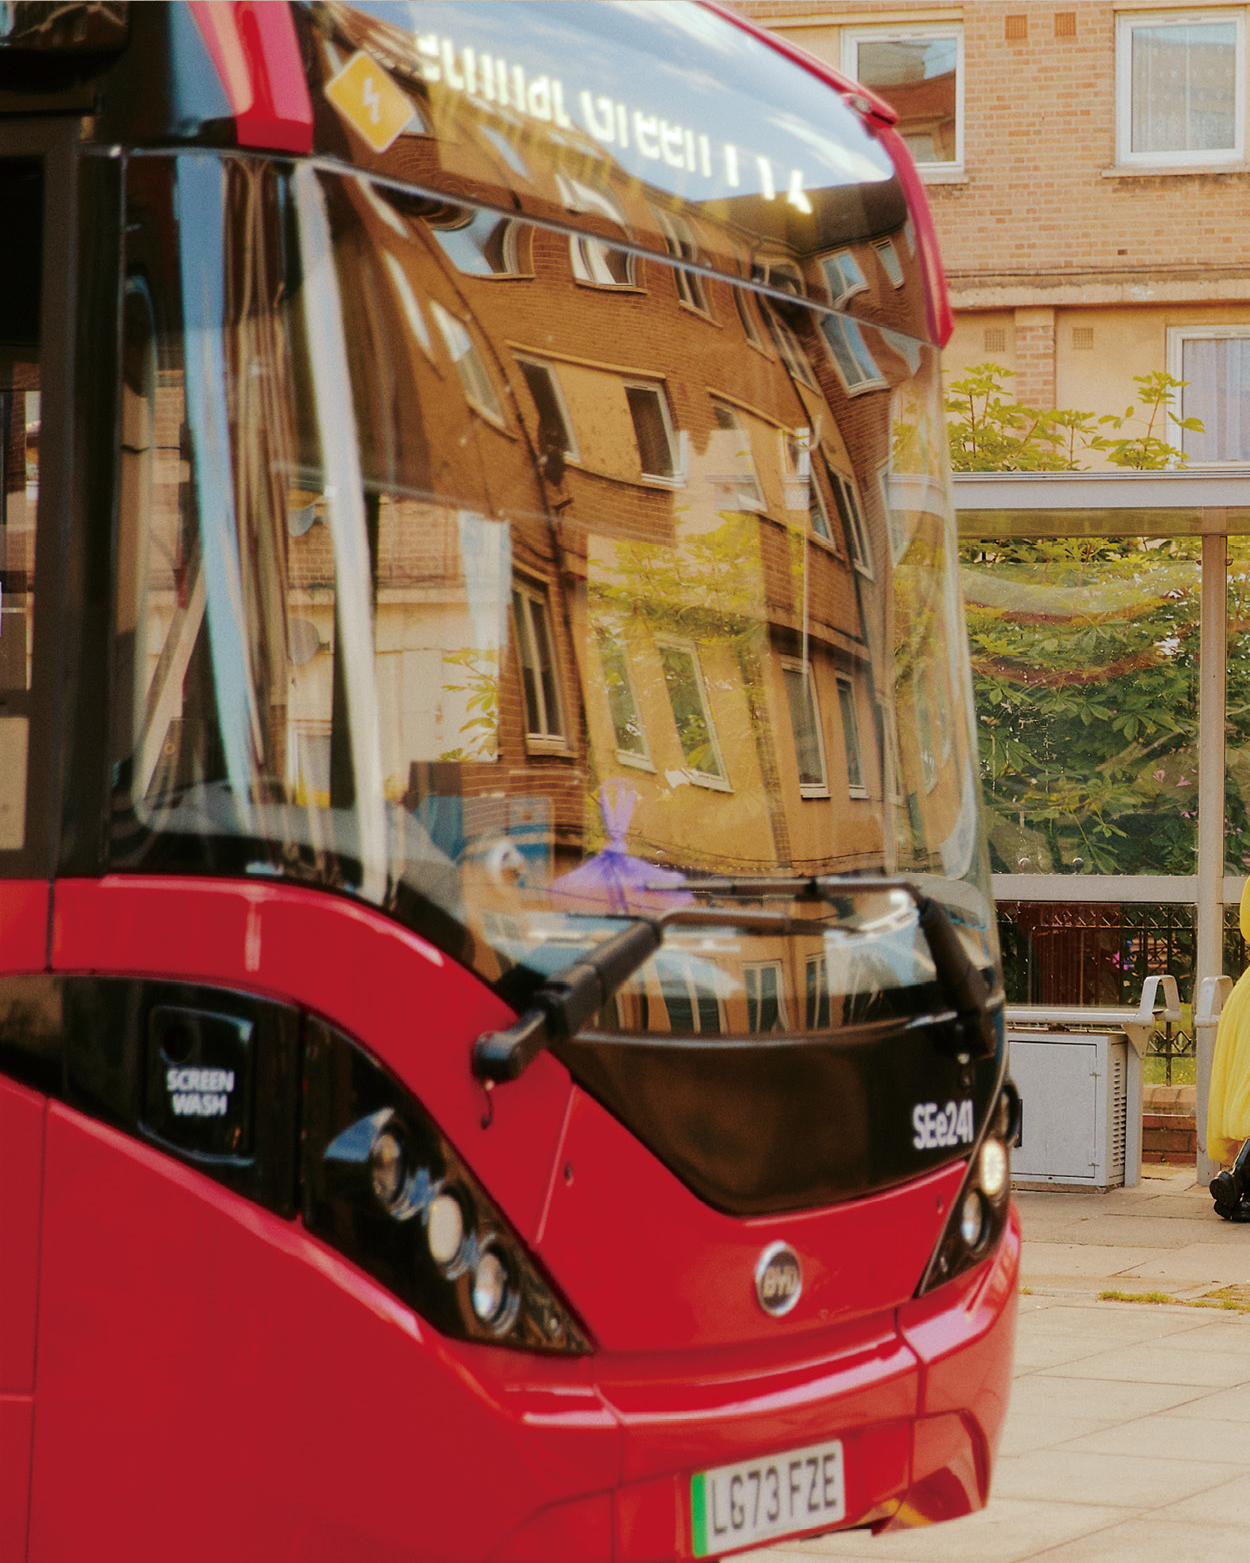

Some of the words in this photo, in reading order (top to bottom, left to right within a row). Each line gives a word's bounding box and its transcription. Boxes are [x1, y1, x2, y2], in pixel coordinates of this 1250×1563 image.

[167, 1066, 235, 1093] SCREEN
[172, 1091, 229, 1117] WASH
[912, 1098, 974, 1150] SEe241
[764, 1265, 798, 1298] BYD
[711, 1464, 780, 1536] LG73
[788, 1452, 837, 1518] FZE
